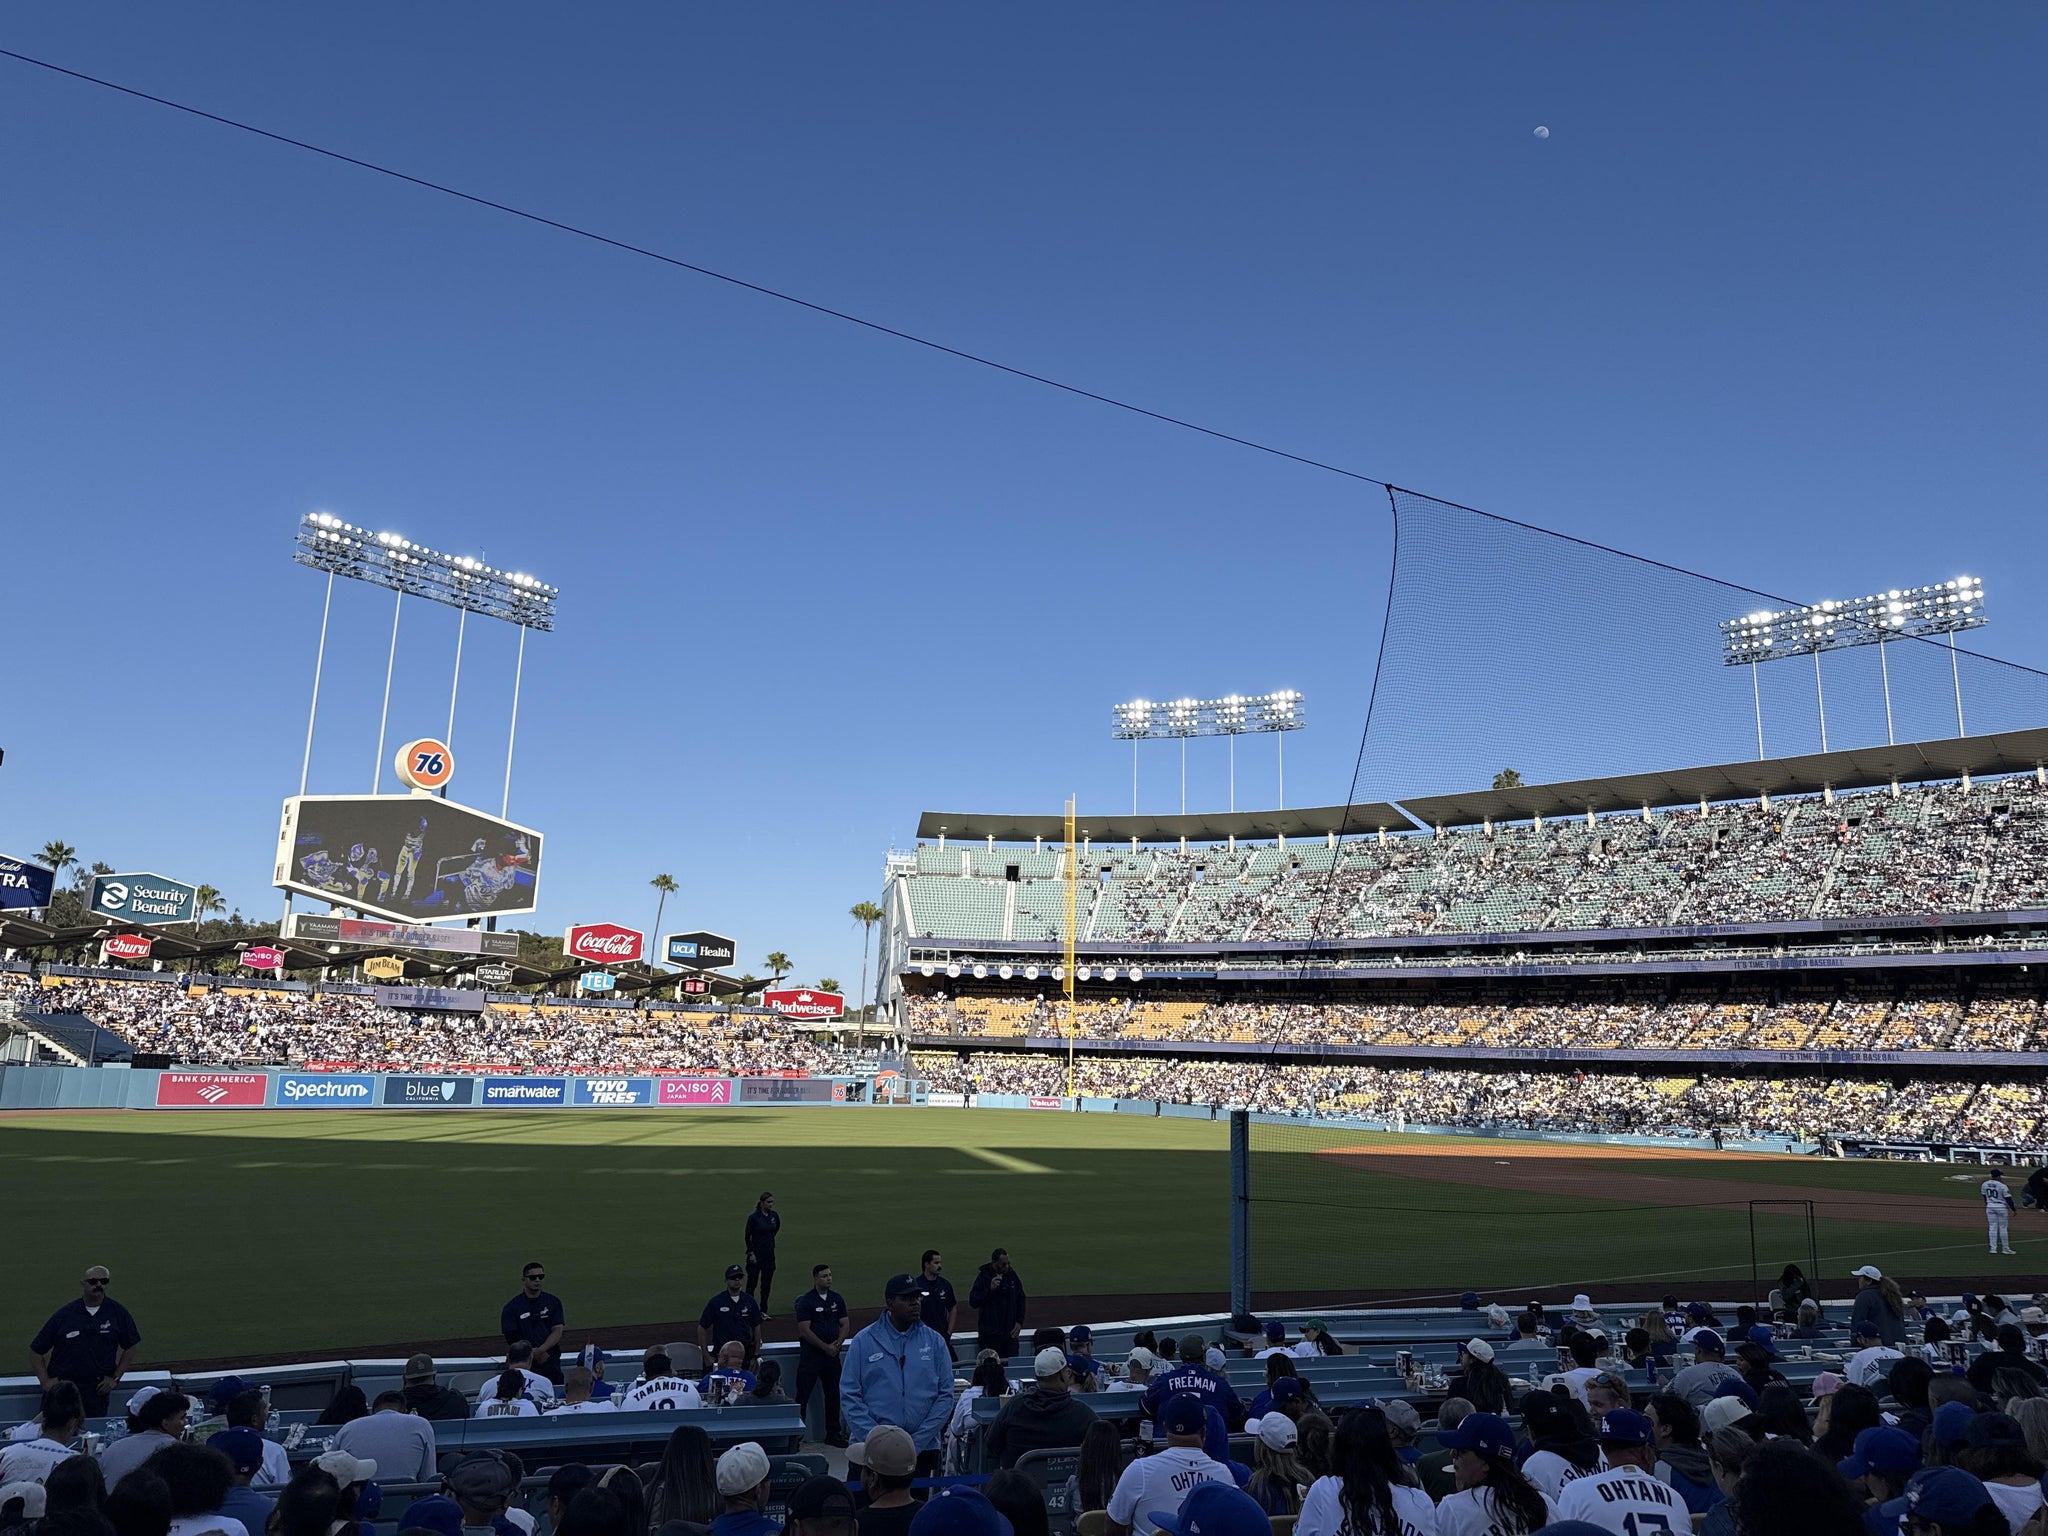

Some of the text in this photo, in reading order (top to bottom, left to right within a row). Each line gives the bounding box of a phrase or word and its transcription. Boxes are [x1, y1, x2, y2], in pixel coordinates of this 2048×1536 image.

[414, 752, 444, 776] 76
[0, 873, 29, 889] RA
[133, 885, 188, 905] Security
[131, 900, 179, 916] Benefit
[1838, 920, 1922, 930] BANK OF AMERICA
[105, 938, 148, 955] Churu
[576, 932, 636, 955] Coca-Cola
[243, 951, 271, 960] DAISO
[672, 944, 731, 958] UCLA Health
[367, 959, 400, 973] JIM BEAM
[1734, 961, 1747, 969] IT'S
[1749, 961, 1765, 969] TIME
[1766, 960, 1780, 968] FOR
[1809, 959, 1845, 967] BASEBALL
[478, 968, 510, 977] STARLUX
[585, 974, 611, 988] TEL
[772, 1000, 836, 1015] Budweiser
[1780, 1053, 1794, 1061] IT'S
[1796, 1053, 1813, 1061] TIME
[1815, 1053, 1830, 1061] FOR
[1863, 1053, 1900, 1062] BASEBALL
[172, 1075, 255, 1083] BANK OF AMERICA
[586, 1081, 625, 1091] TOYO
[284, 1080, 363, 1100] Spectrum
[406, 1081, 439, 1096] blue
[487, 1085, 560, 1099] smartwater
[667, 1083, 709, 1093] DAISO
[834, 1088, 844, 1096] 76
[592, 1091, 637, 1103] TIRES
[1031, 1099, 1061, 1107] Yakult
[634, 1378, 689, 1402] YAMAMOTO
[1168, 1376, 1217, 1393] FREEMAN
[487, 1405, 520, 1417] OHTANI
[1602, 1416, 1611, 1432] LA
[1597, 1480, 1673, 1507] OHTANI
[1048, 1496, 1065, 1508] 43
